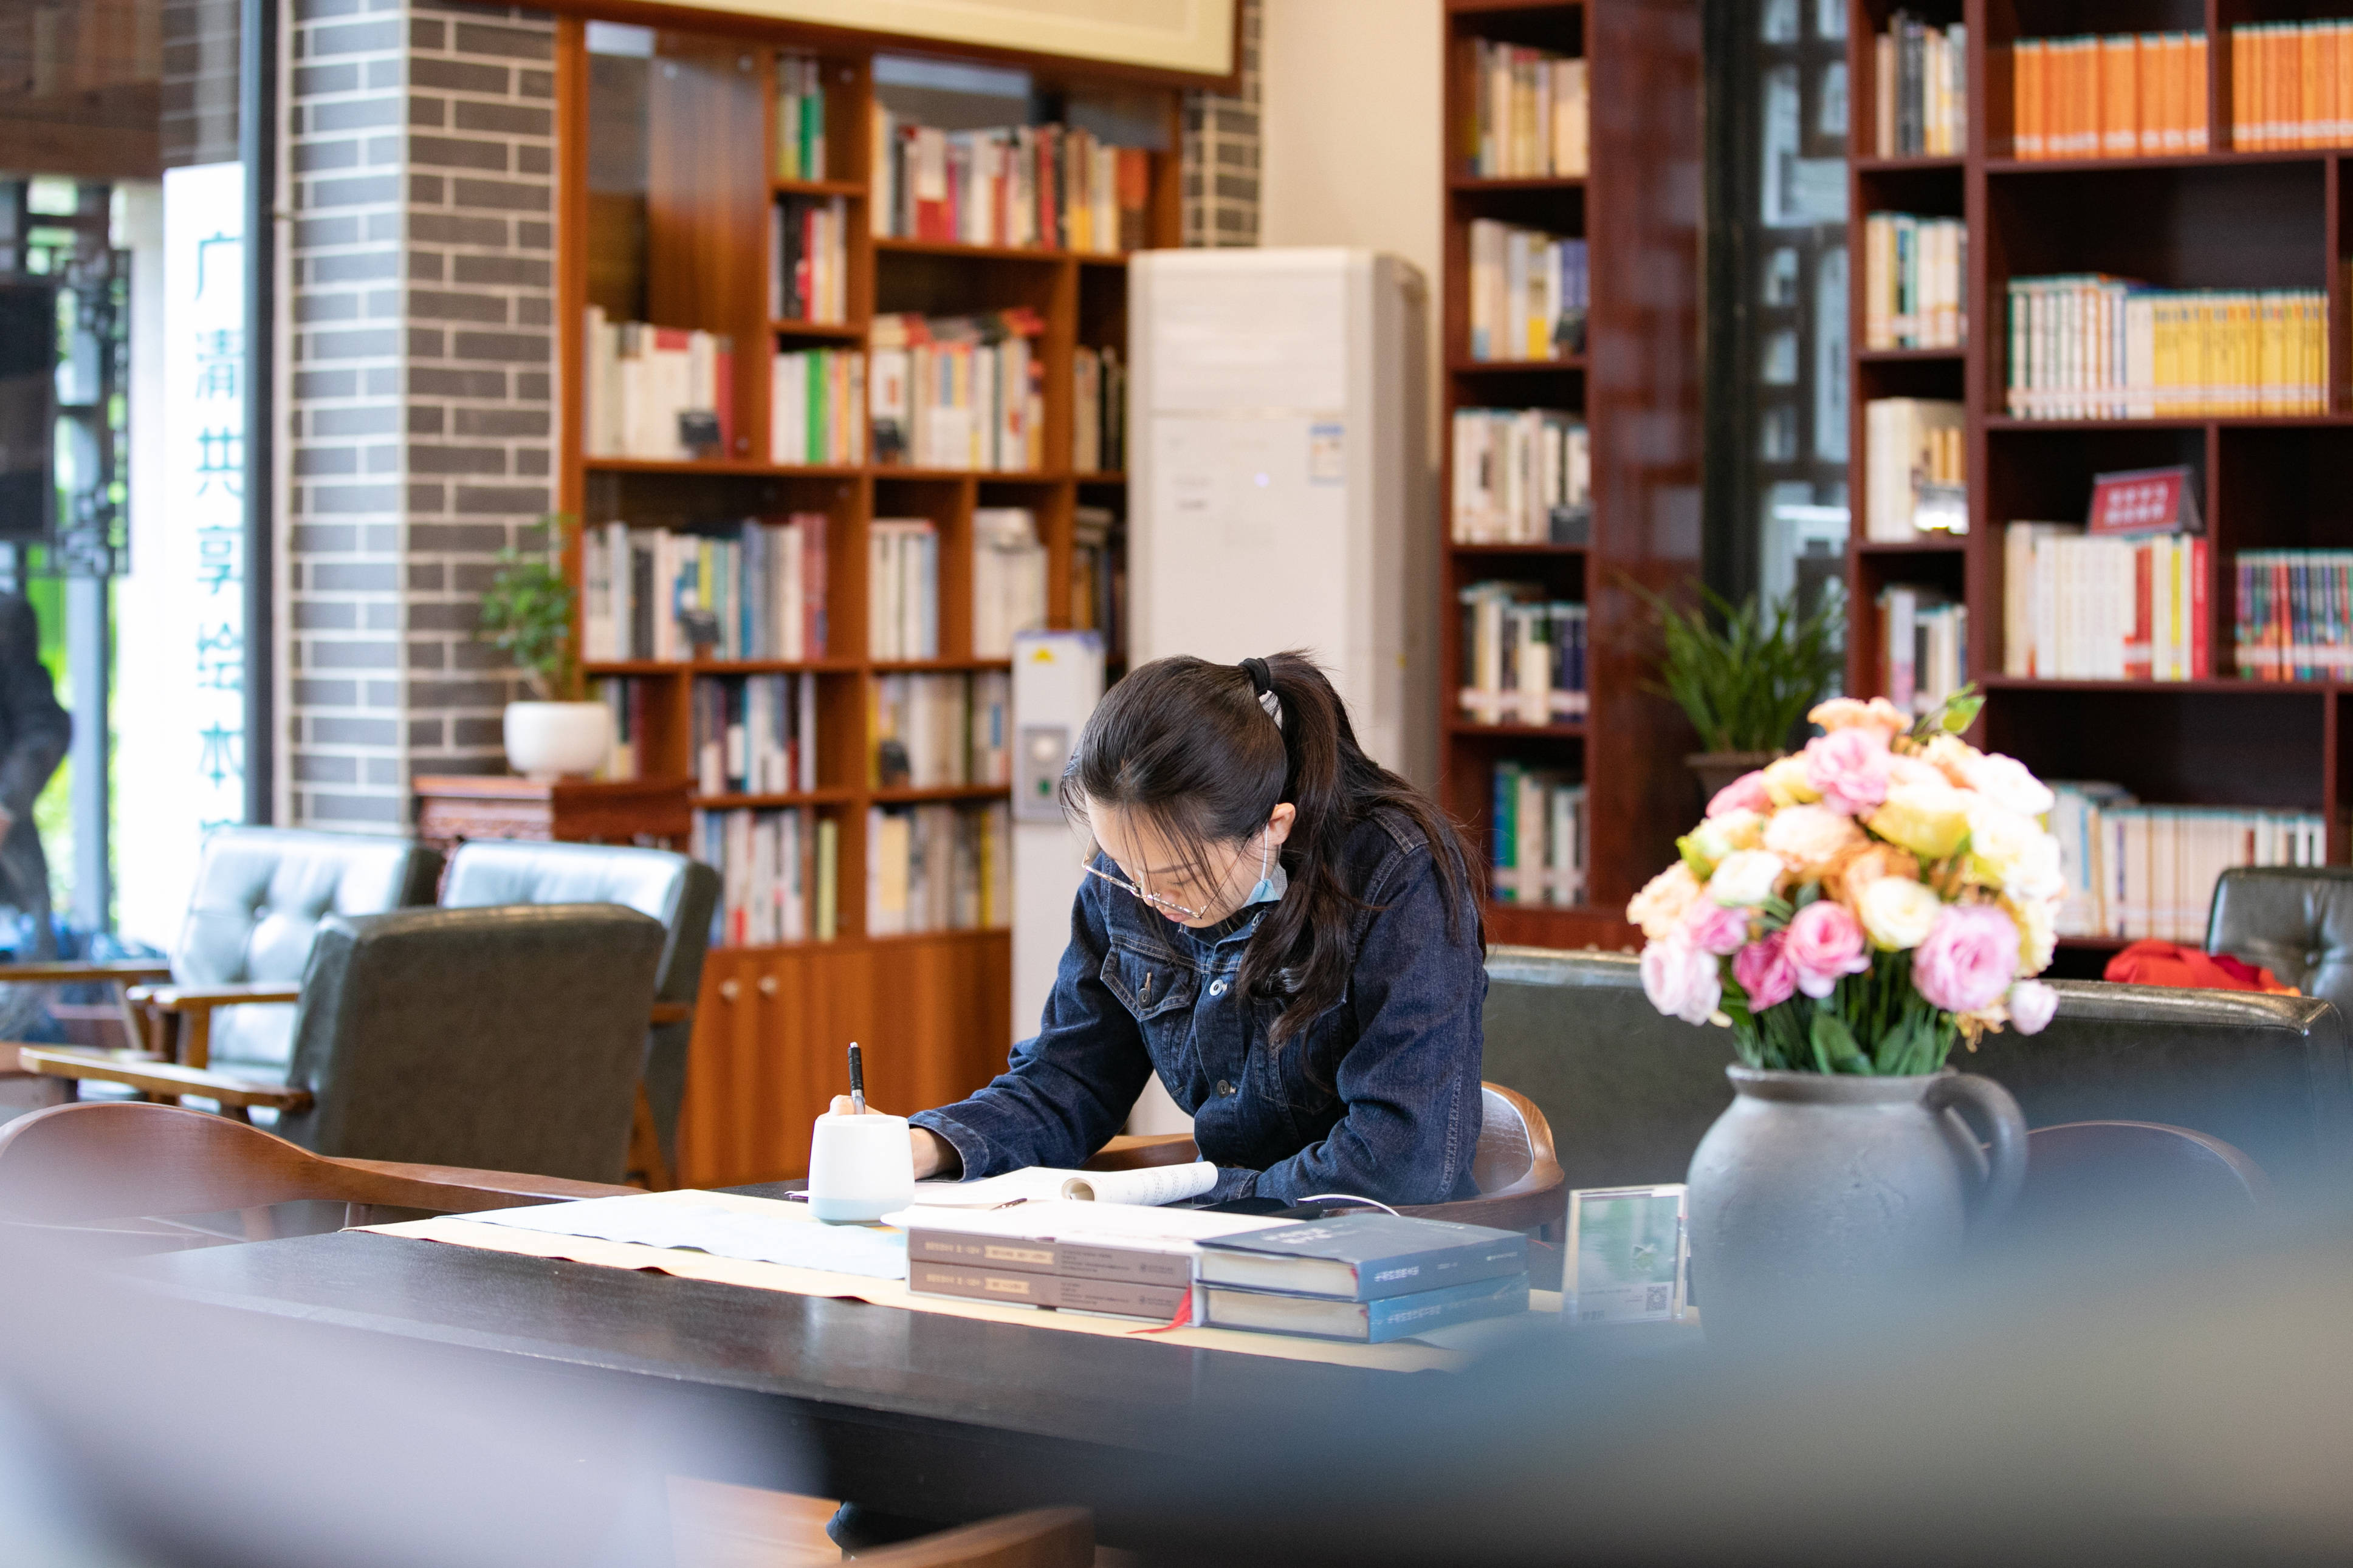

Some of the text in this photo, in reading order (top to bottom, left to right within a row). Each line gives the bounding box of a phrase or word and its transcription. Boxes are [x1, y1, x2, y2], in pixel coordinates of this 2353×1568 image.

[196, 231, 244, 834] 广清共享绘本
